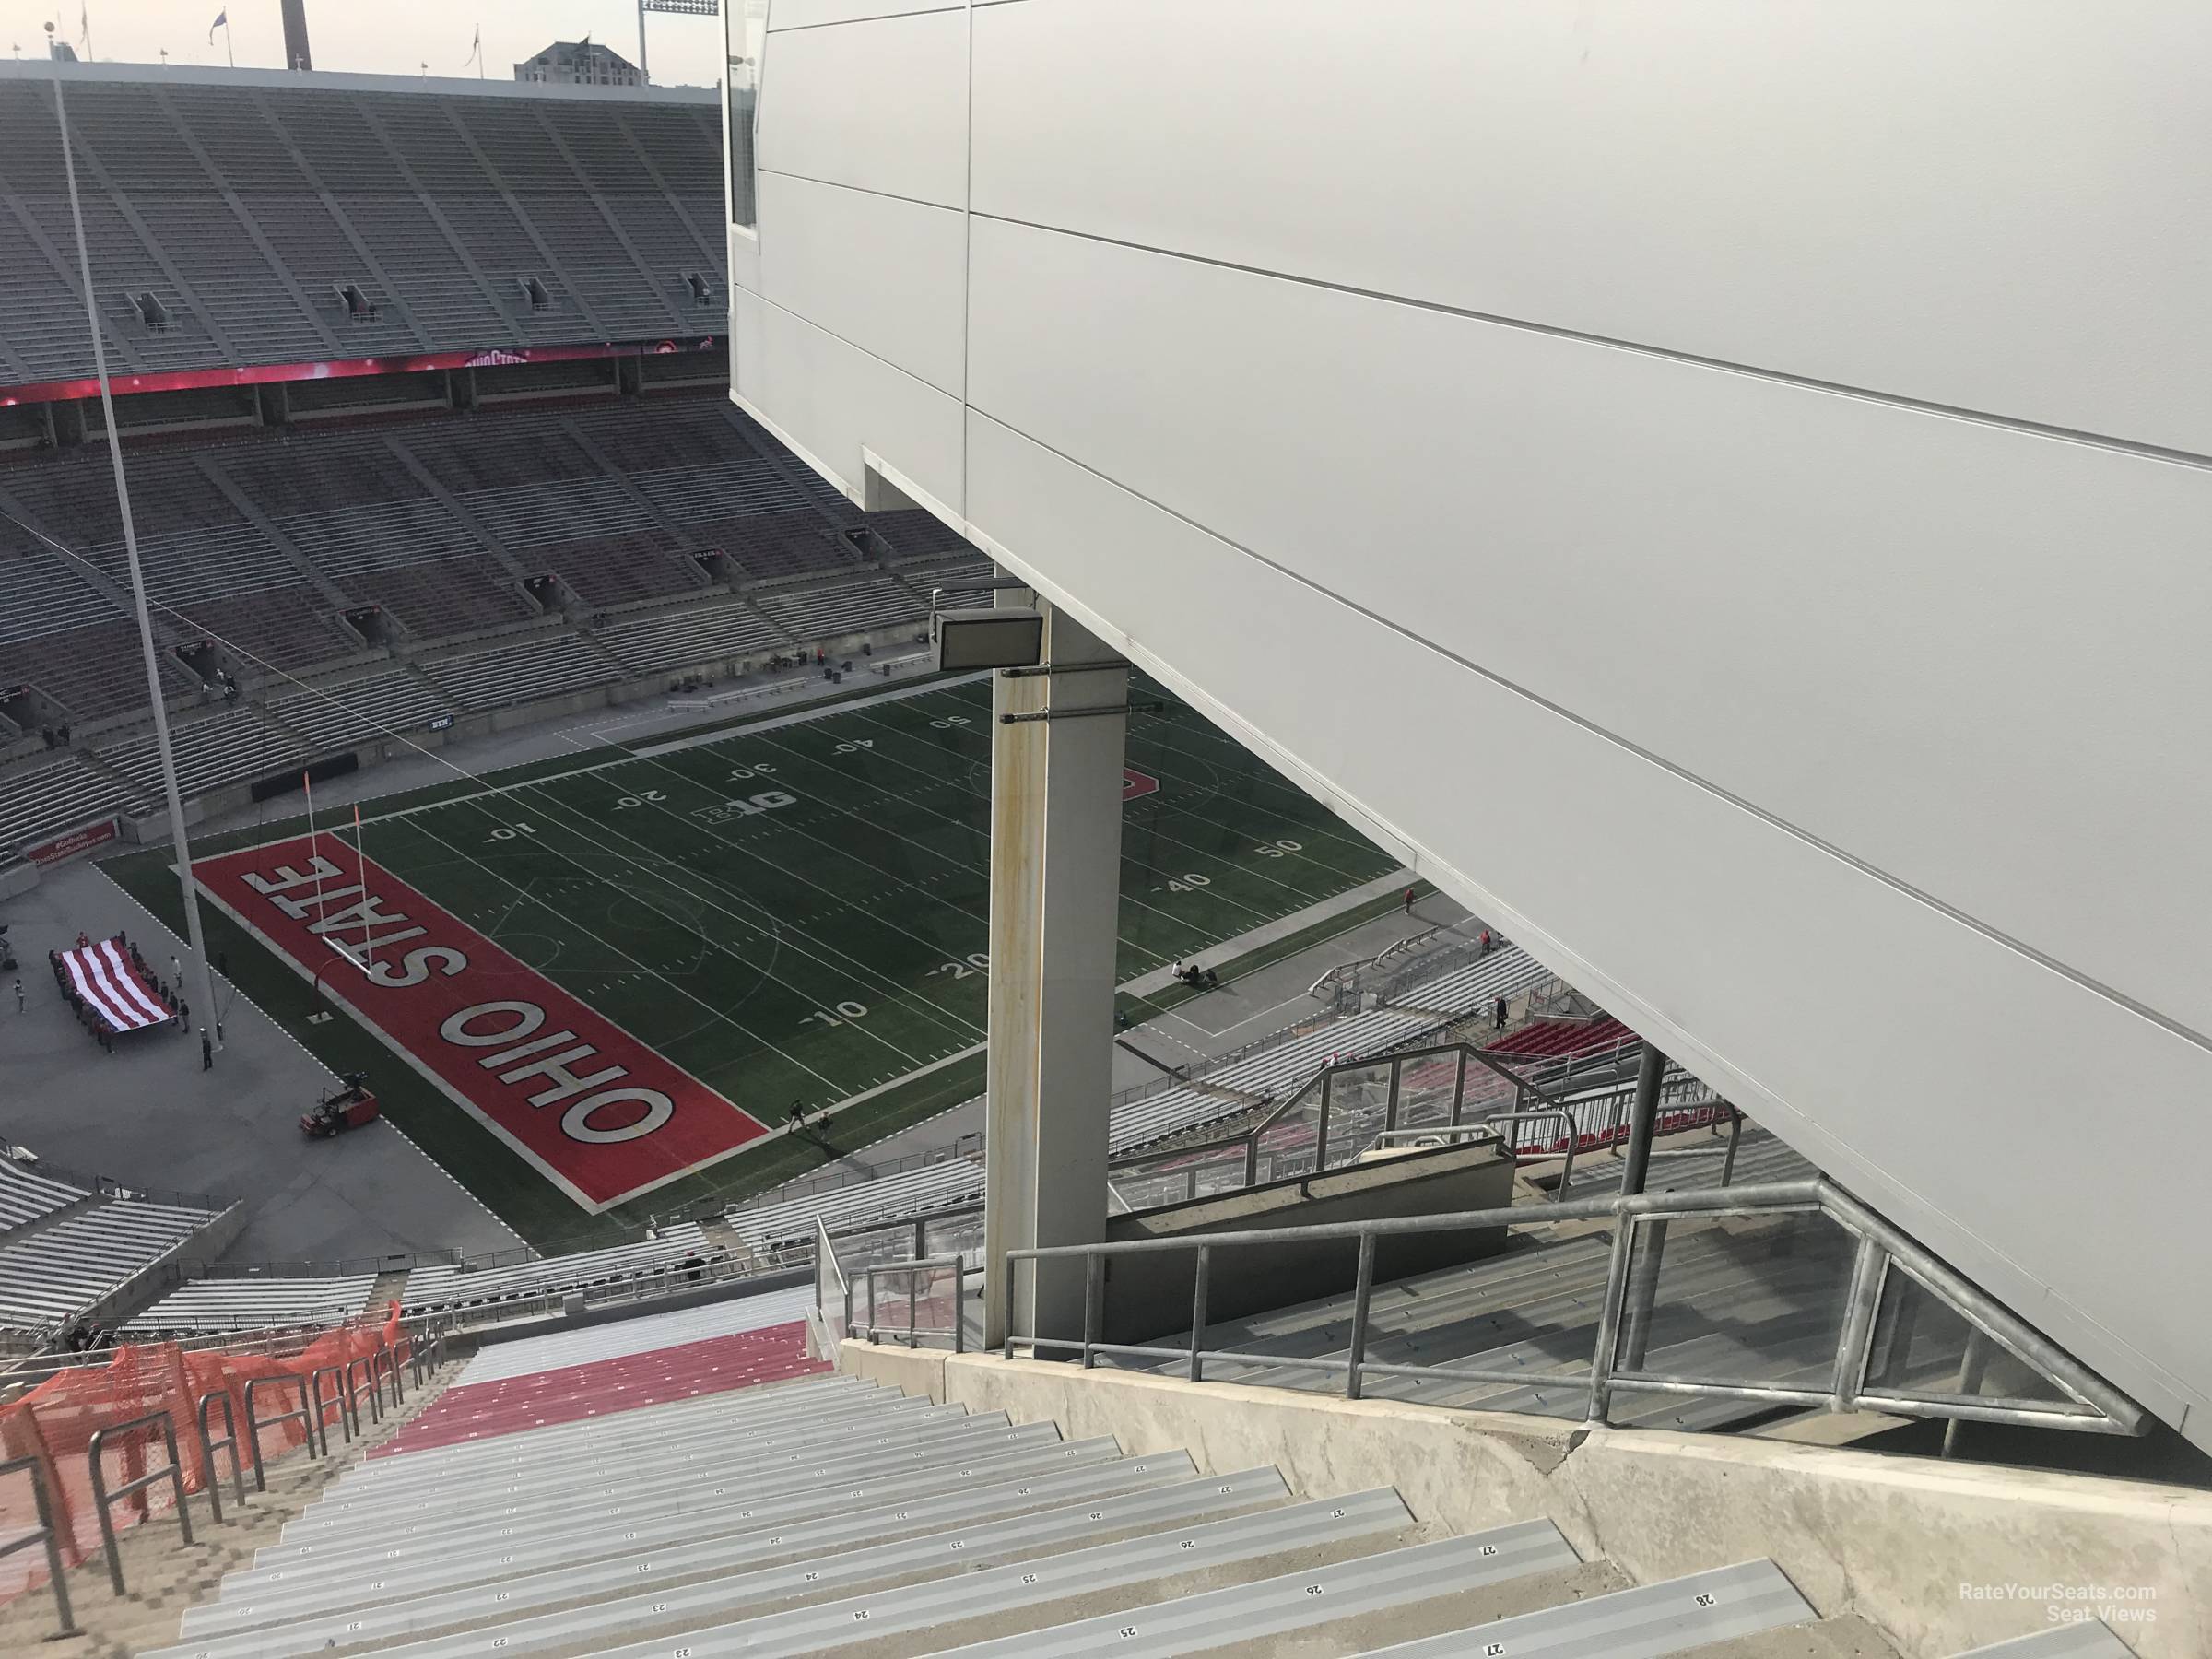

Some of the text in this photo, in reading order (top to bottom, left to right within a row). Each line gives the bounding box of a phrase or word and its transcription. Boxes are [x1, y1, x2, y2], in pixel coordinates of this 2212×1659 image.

[929, 715, 972, 729] 50
[835, 739, 874, 753] 40
[731, 763, 777, 779] 30
[616, 790, 668, 808] 20
[490, 822, 538, 841] 10
[1253, 840, 1303, 858] 50
[1168, 873, 1211, 892] 40
[240, 855, 468, 988] STATE
[941, 953, 990, 980] 20
[813, 1001, 868, 1027] 10
[440, 1000, 676, 1143] OHIO
[1334, 1509, 1345, 1518] 27
[951, 1541, 963, 1549] 25
[1181, 1540, 1194, 1549] 26
[1483, 1546, 1497, 1556] 27
[806, 1572, 818, 1581] 24
[1022, 1575, 1036, 1583] 25
[1306, 1585, 1323, 1595] 26
[1696, 1594, 1714, 1606] 28
[855, 1611, 868, 1619] 24
[1120, 1627, 1136, 1638] 25
[494, 1639, 507, 1647] 22
[675, 1649, 689, 1658] 23
[1488, 1643, 1504, 1656] 27
